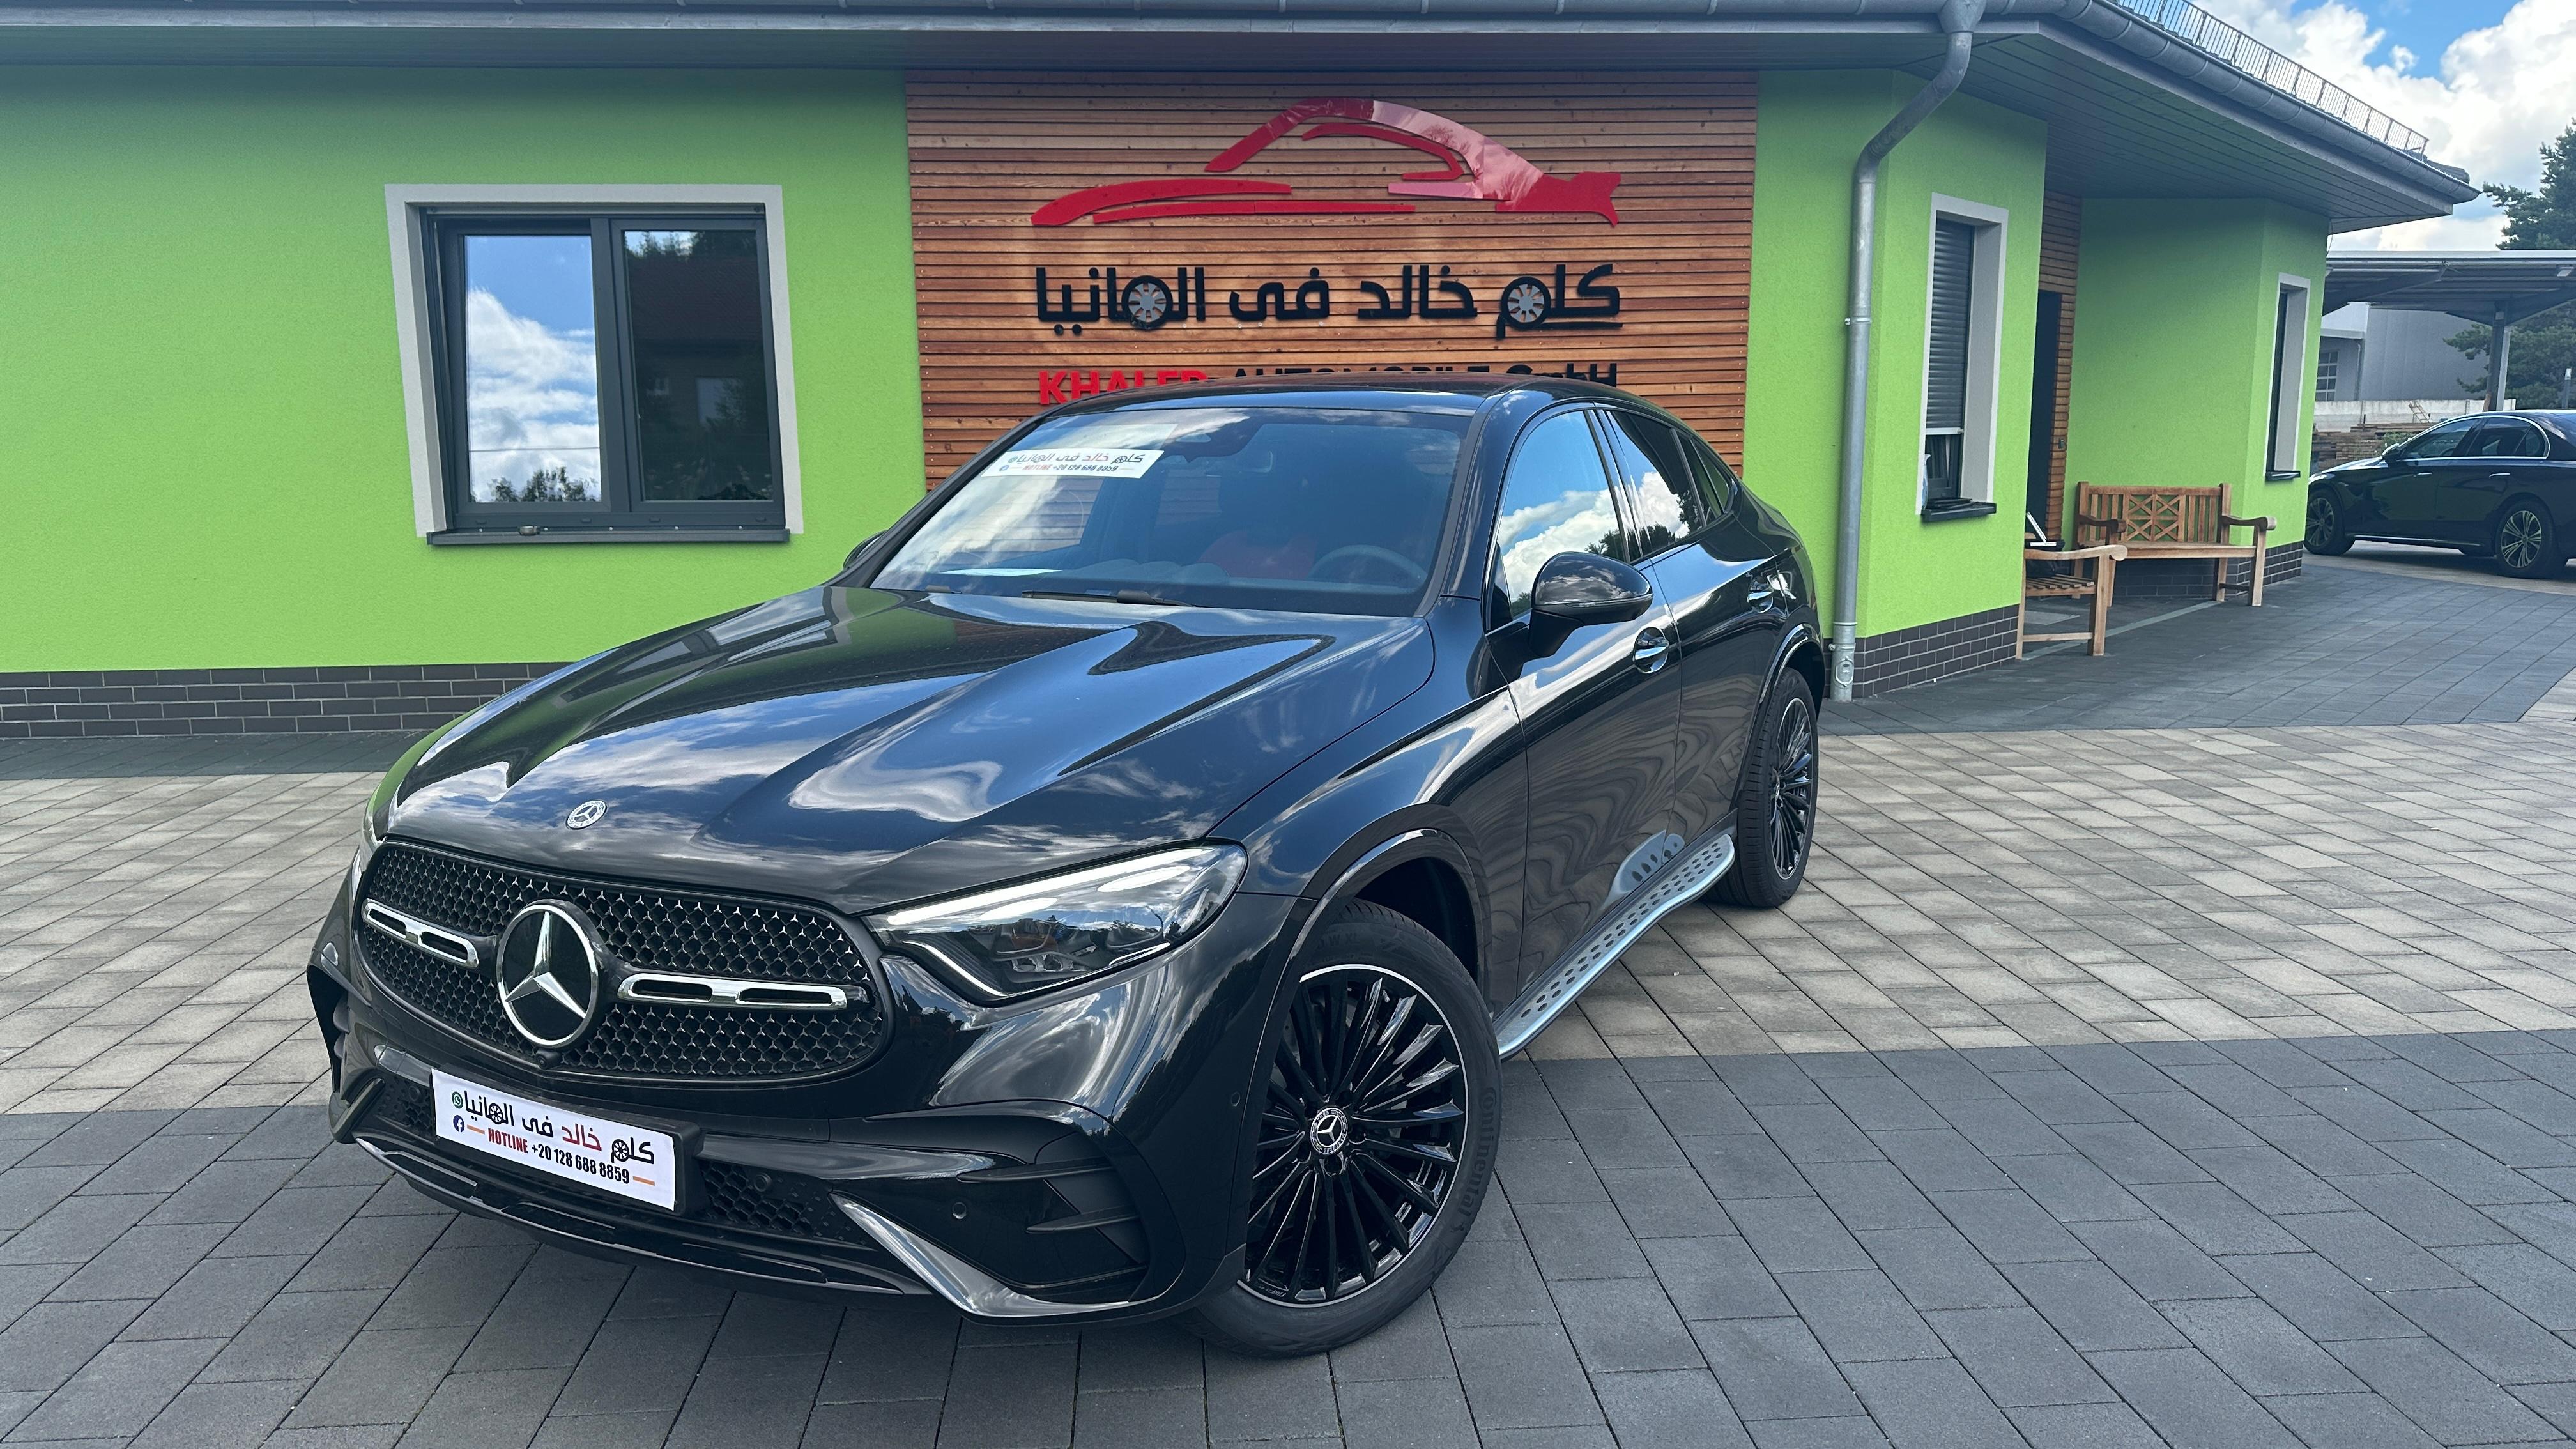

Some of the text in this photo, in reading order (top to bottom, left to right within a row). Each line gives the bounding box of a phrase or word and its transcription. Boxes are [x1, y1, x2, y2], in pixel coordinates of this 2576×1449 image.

[1357, 264, 1478, 319] خالد
[487, 1127, 630, 1184] HOTLINE +20 128 688 8859
[562, 1123, 602, 1151] خالد
